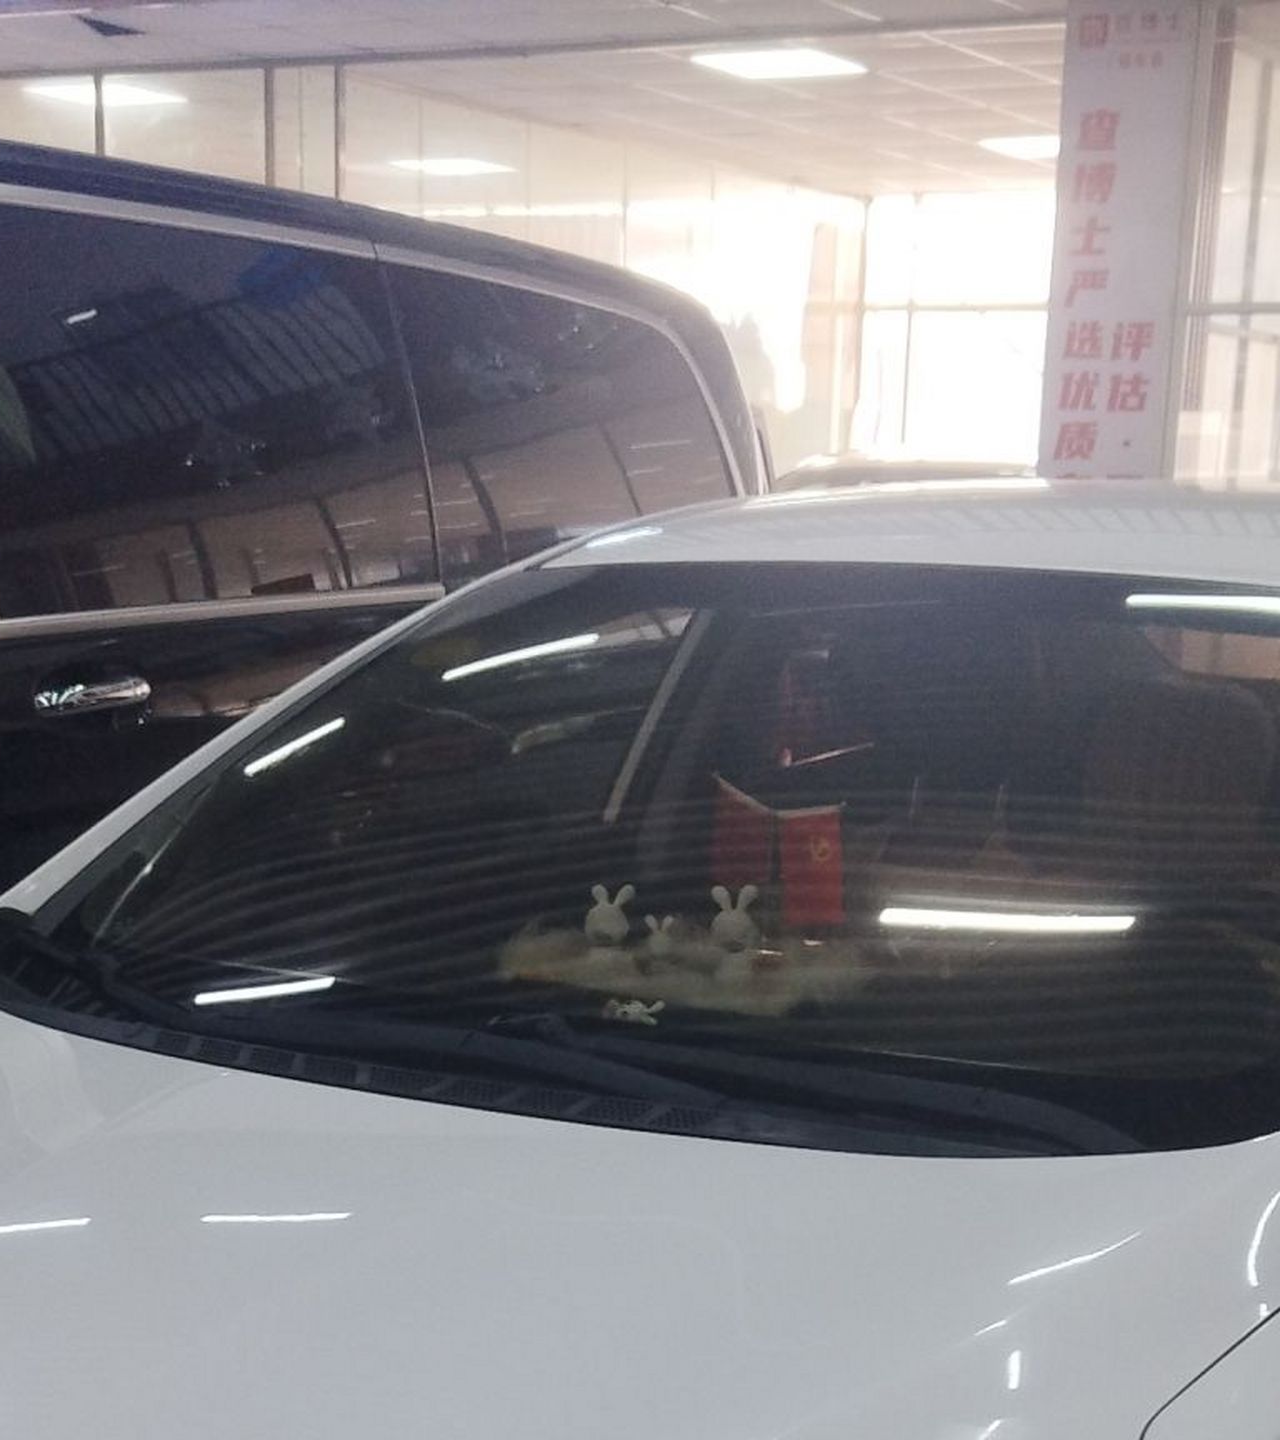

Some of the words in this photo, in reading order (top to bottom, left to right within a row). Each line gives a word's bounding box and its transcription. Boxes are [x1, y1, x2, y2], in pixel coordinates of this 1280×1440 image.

[1053, 107, 1122, 479] 查博士严选优质
